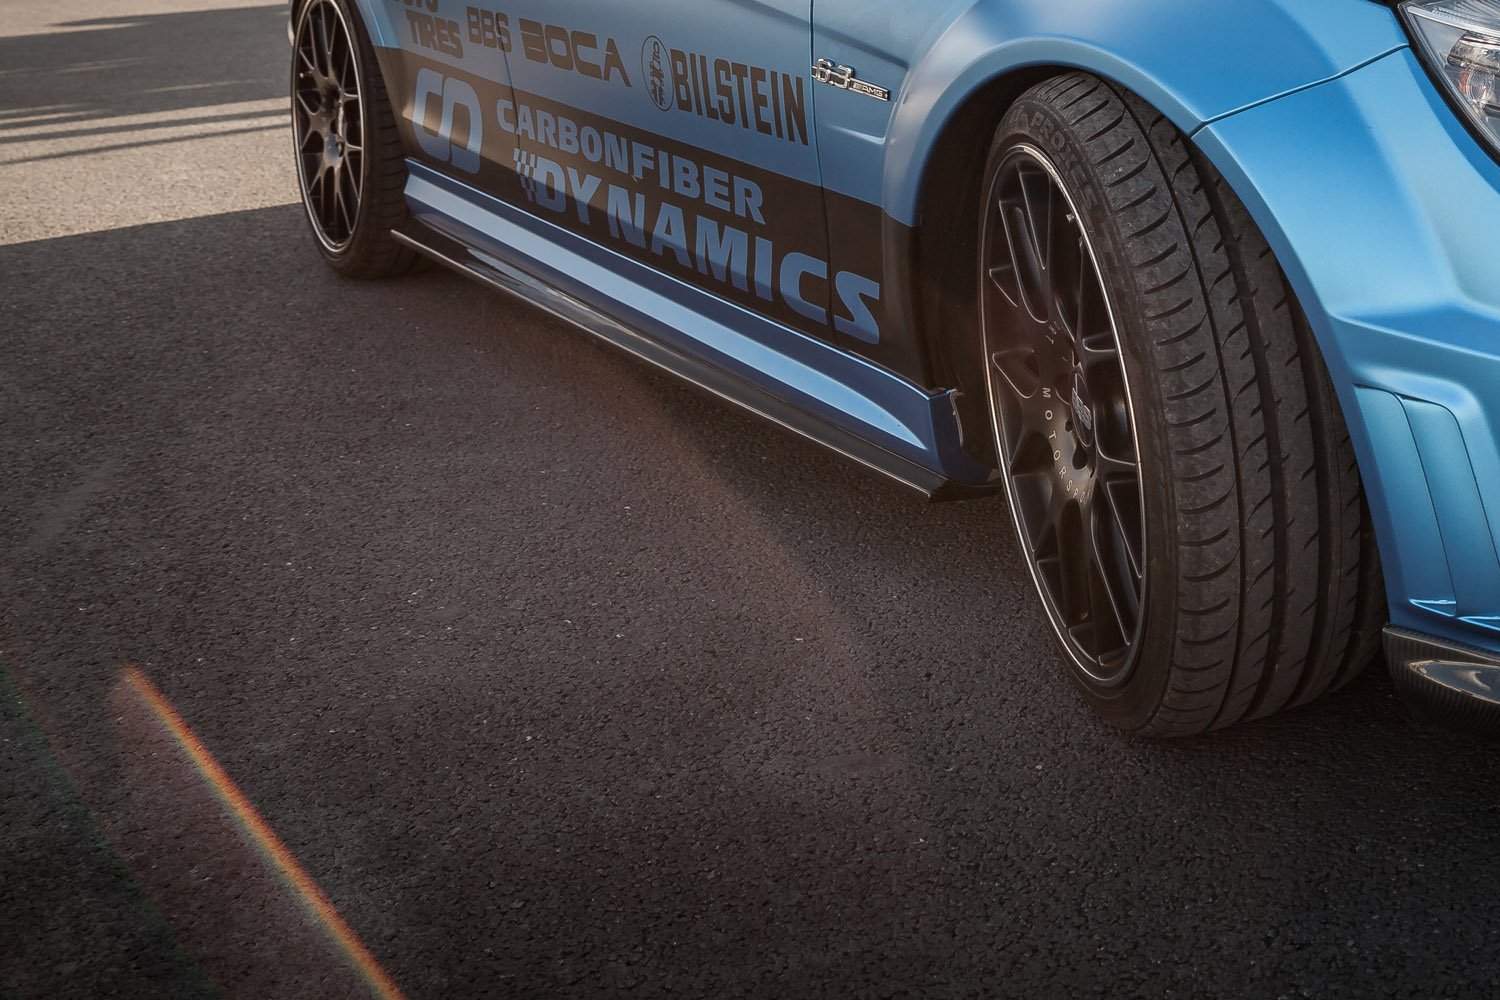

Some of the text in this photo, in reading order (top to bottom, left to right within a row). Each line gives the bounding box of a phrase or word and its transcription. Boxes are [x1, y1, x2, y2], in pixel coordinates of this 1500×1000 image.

[467, 6, 512, 53] BBS
[518, 17, 632, 88] BOCA
[670, 48, 809, 147] BILSTEIN
[861, 84, 884, 98] AMG
[496, 99, 766, 226] CARBONFIBER
[531, 156, 880, 345] DYNAMICS
